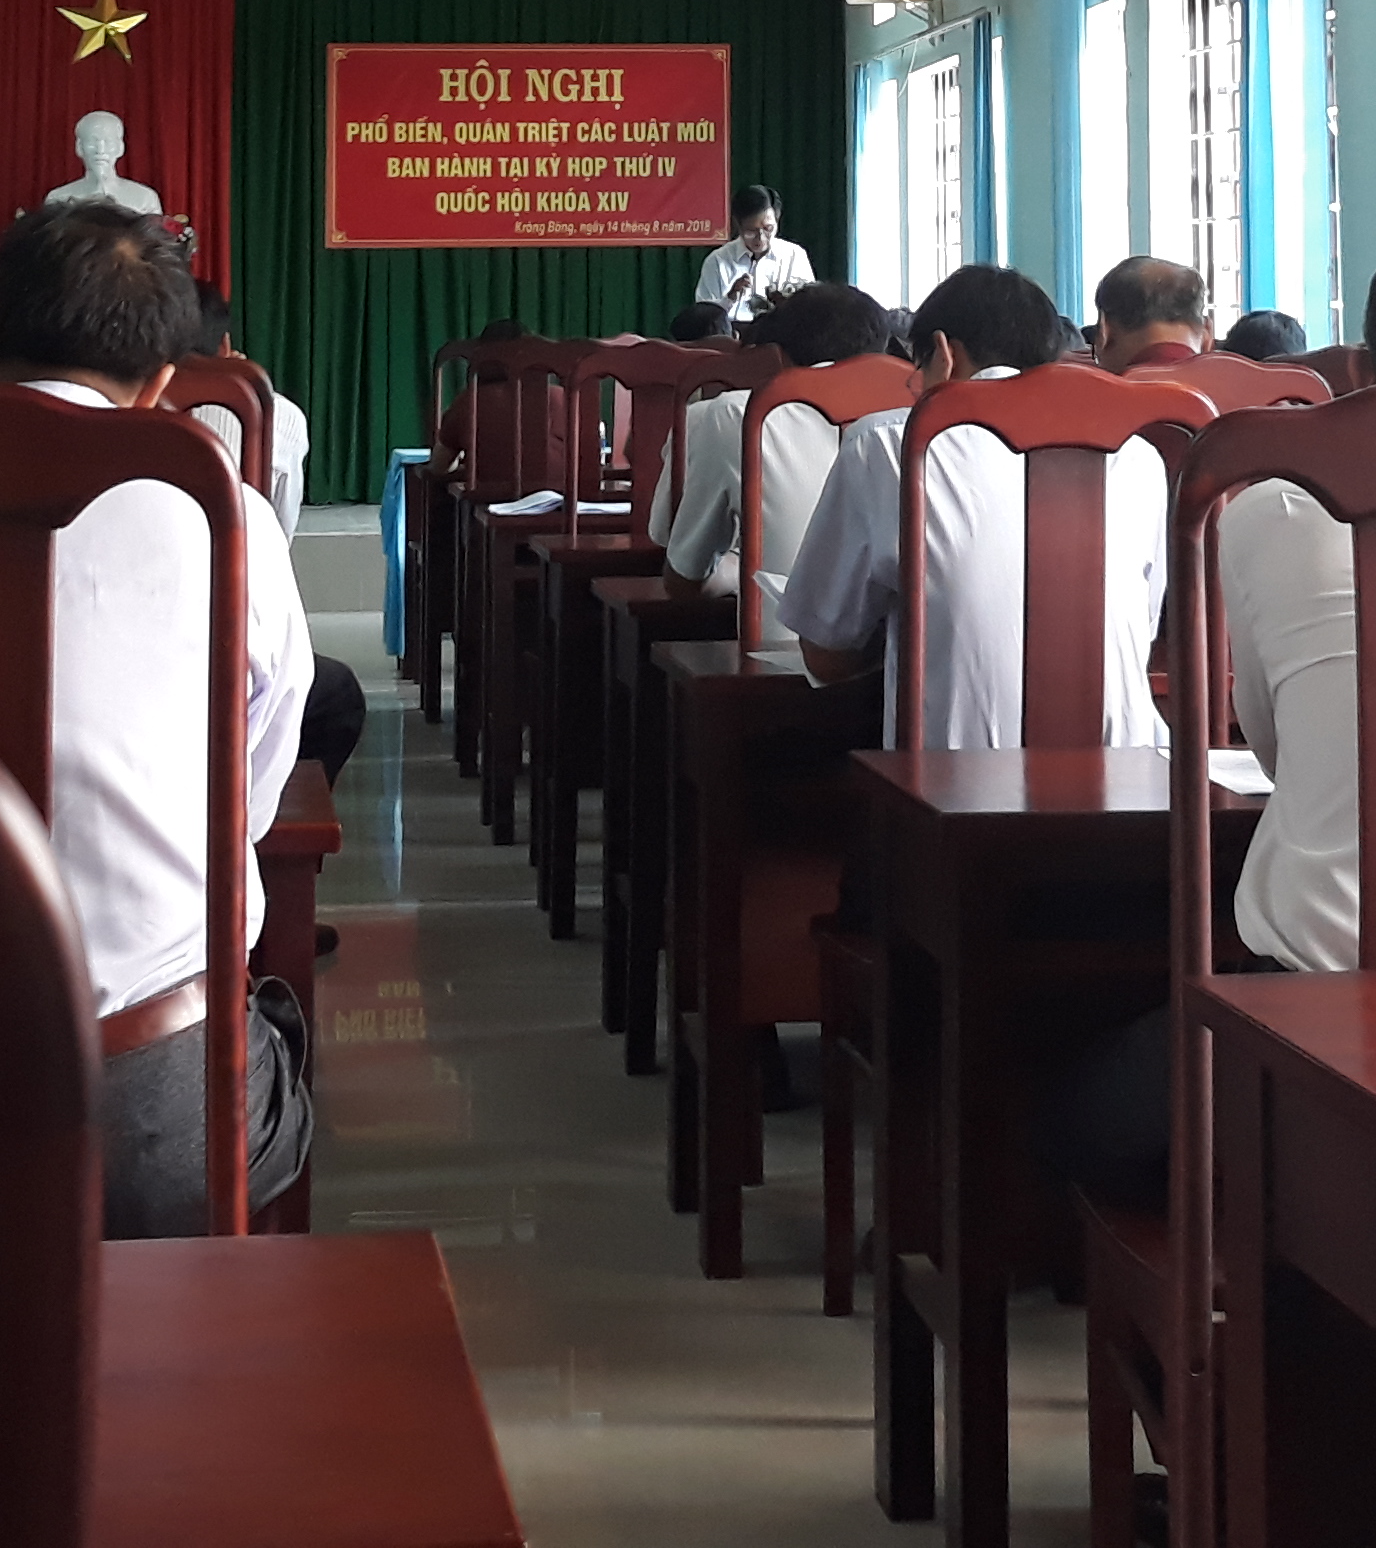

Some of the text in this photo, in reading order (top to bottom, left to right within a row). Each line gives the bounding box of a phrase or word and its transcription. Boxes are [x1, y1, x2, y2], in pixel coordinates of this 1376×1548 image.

[439, 58, 624, 111] HỘI NGHỊ
[394, 116, 448, 145] BIẾN,
[516, 118, 571, 147] TRIỆT
[576, 117, 617, 143] CÁC
[623, 117, 671, 147] LUẬT
[677, 117, 715, 143] MỚI
[387, 156, 430, 178] BAN
[436, 152, 492, 178] HÀNH
[498, 156, 529, 183] TẠI
[567, 156, 608, 182] HỌP
[614, 152, 654, 178] THỨ
[658, 156, 676, 178] IV
[435, 184, 630, 217] QUỐC HỘI KHÓA XIV
[652, 220, 660, 232] 8
[686, 220, 712, 233] 2018
